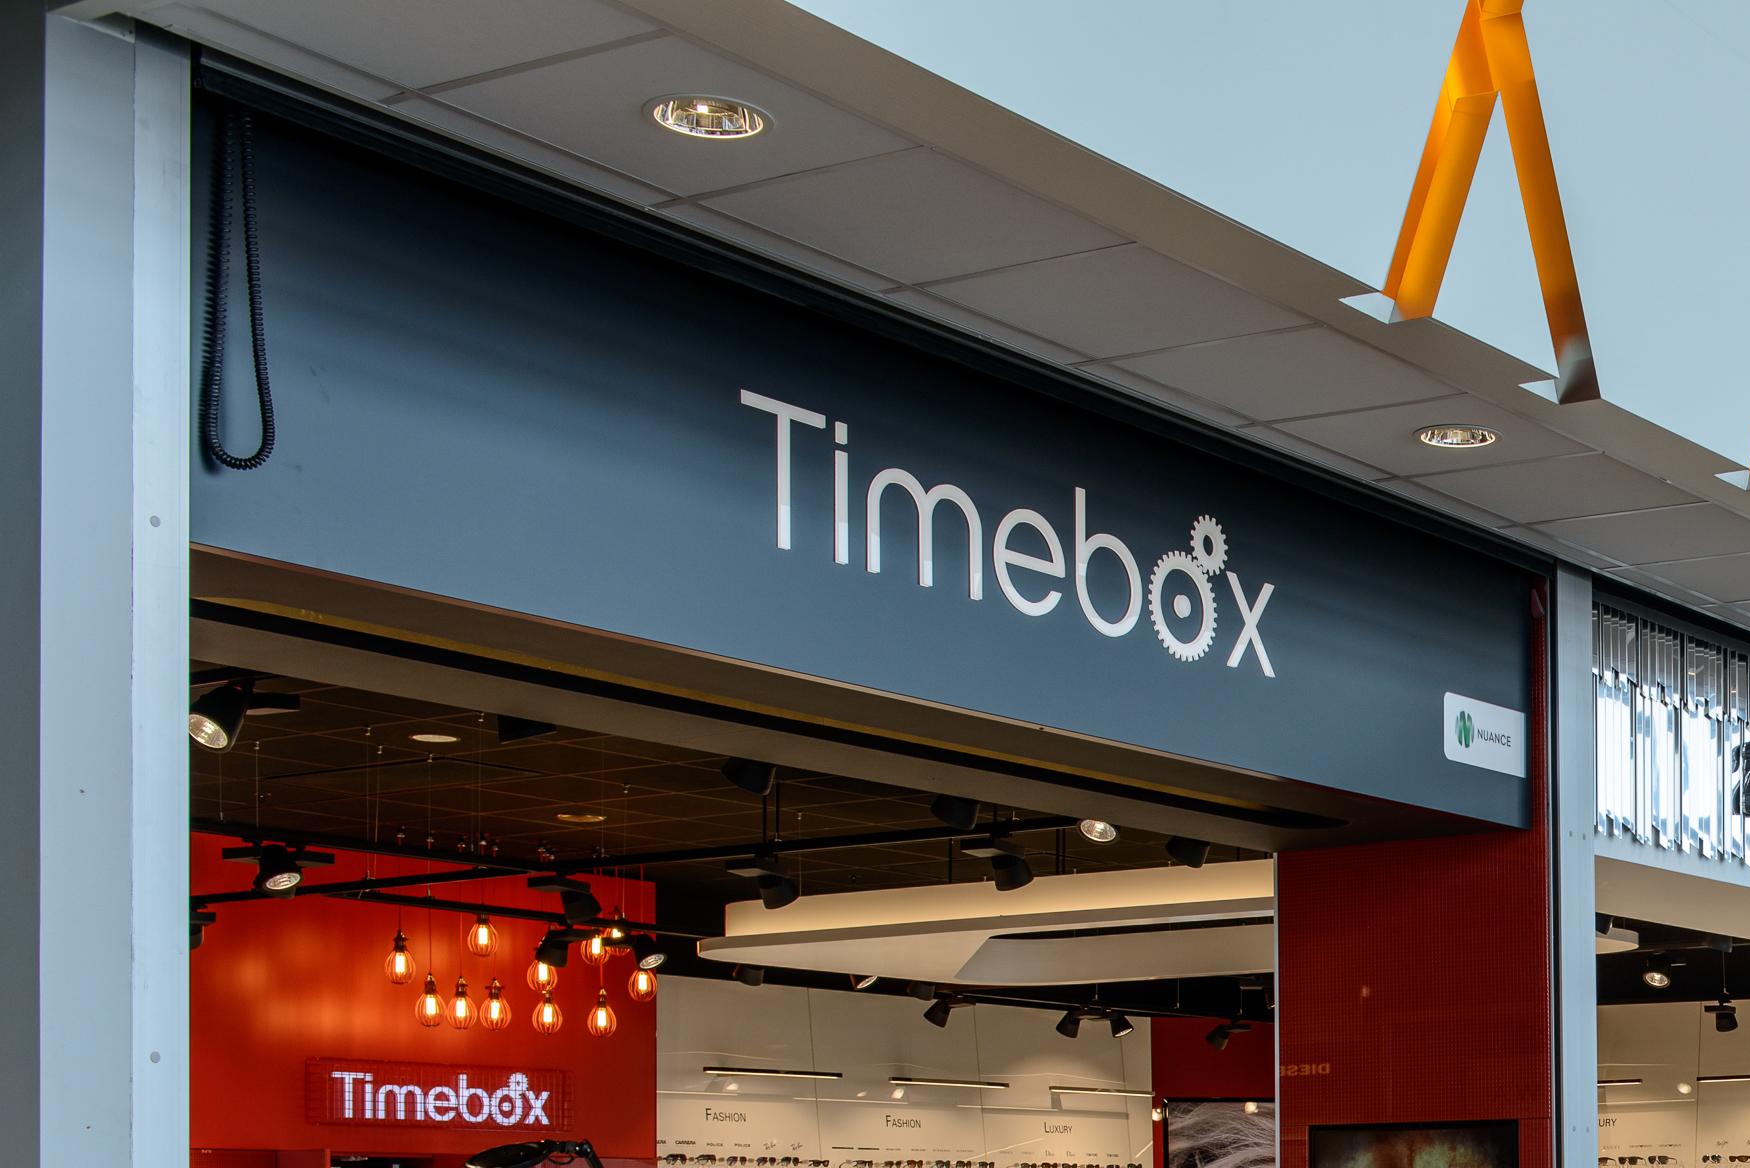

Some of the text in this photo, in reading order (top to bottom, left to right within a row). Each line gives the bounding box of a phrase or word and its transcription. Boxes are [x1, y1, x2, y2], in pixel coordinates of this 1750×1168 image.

[741, 389, 1275, 678] Timebox
[1477, 728, 1512, 747] NUANCE
[331, 1071, 550, 1126] Timebox
[705, 1108, 747, 1122] FASHION
[885, 1114, 922, 1129] FASHION
[1598, 1118, 1618, 1127] URY
[1044, 1121, 1073, 1134] LUXURY
